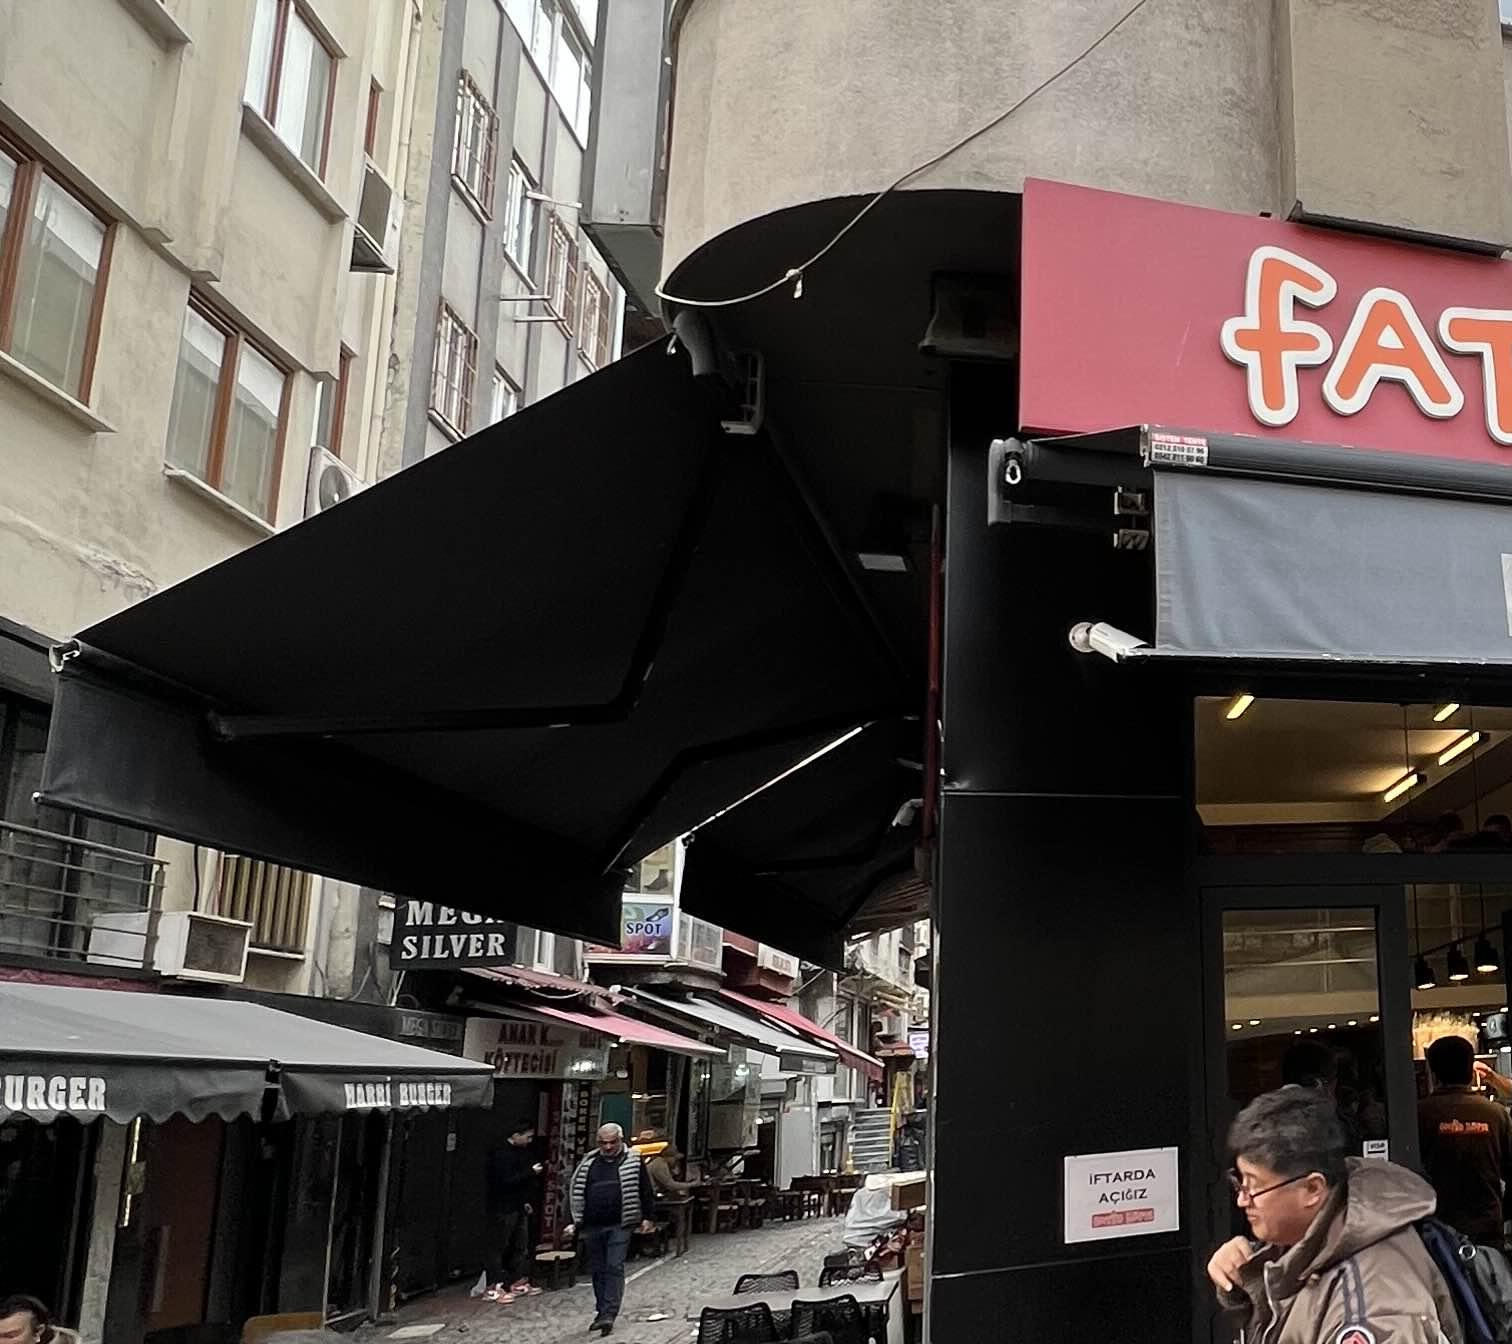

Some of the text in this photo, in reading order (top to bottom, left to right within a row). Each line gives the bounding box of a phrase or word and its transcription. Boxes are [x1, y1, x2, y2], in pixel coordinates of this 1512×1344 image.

[405, 900, 505, 926] MEG
[626, 921, 662, 936] SPOT
[401, 933, 505, 960] SILVER
[0, 1075, 106, 1112] URGER
